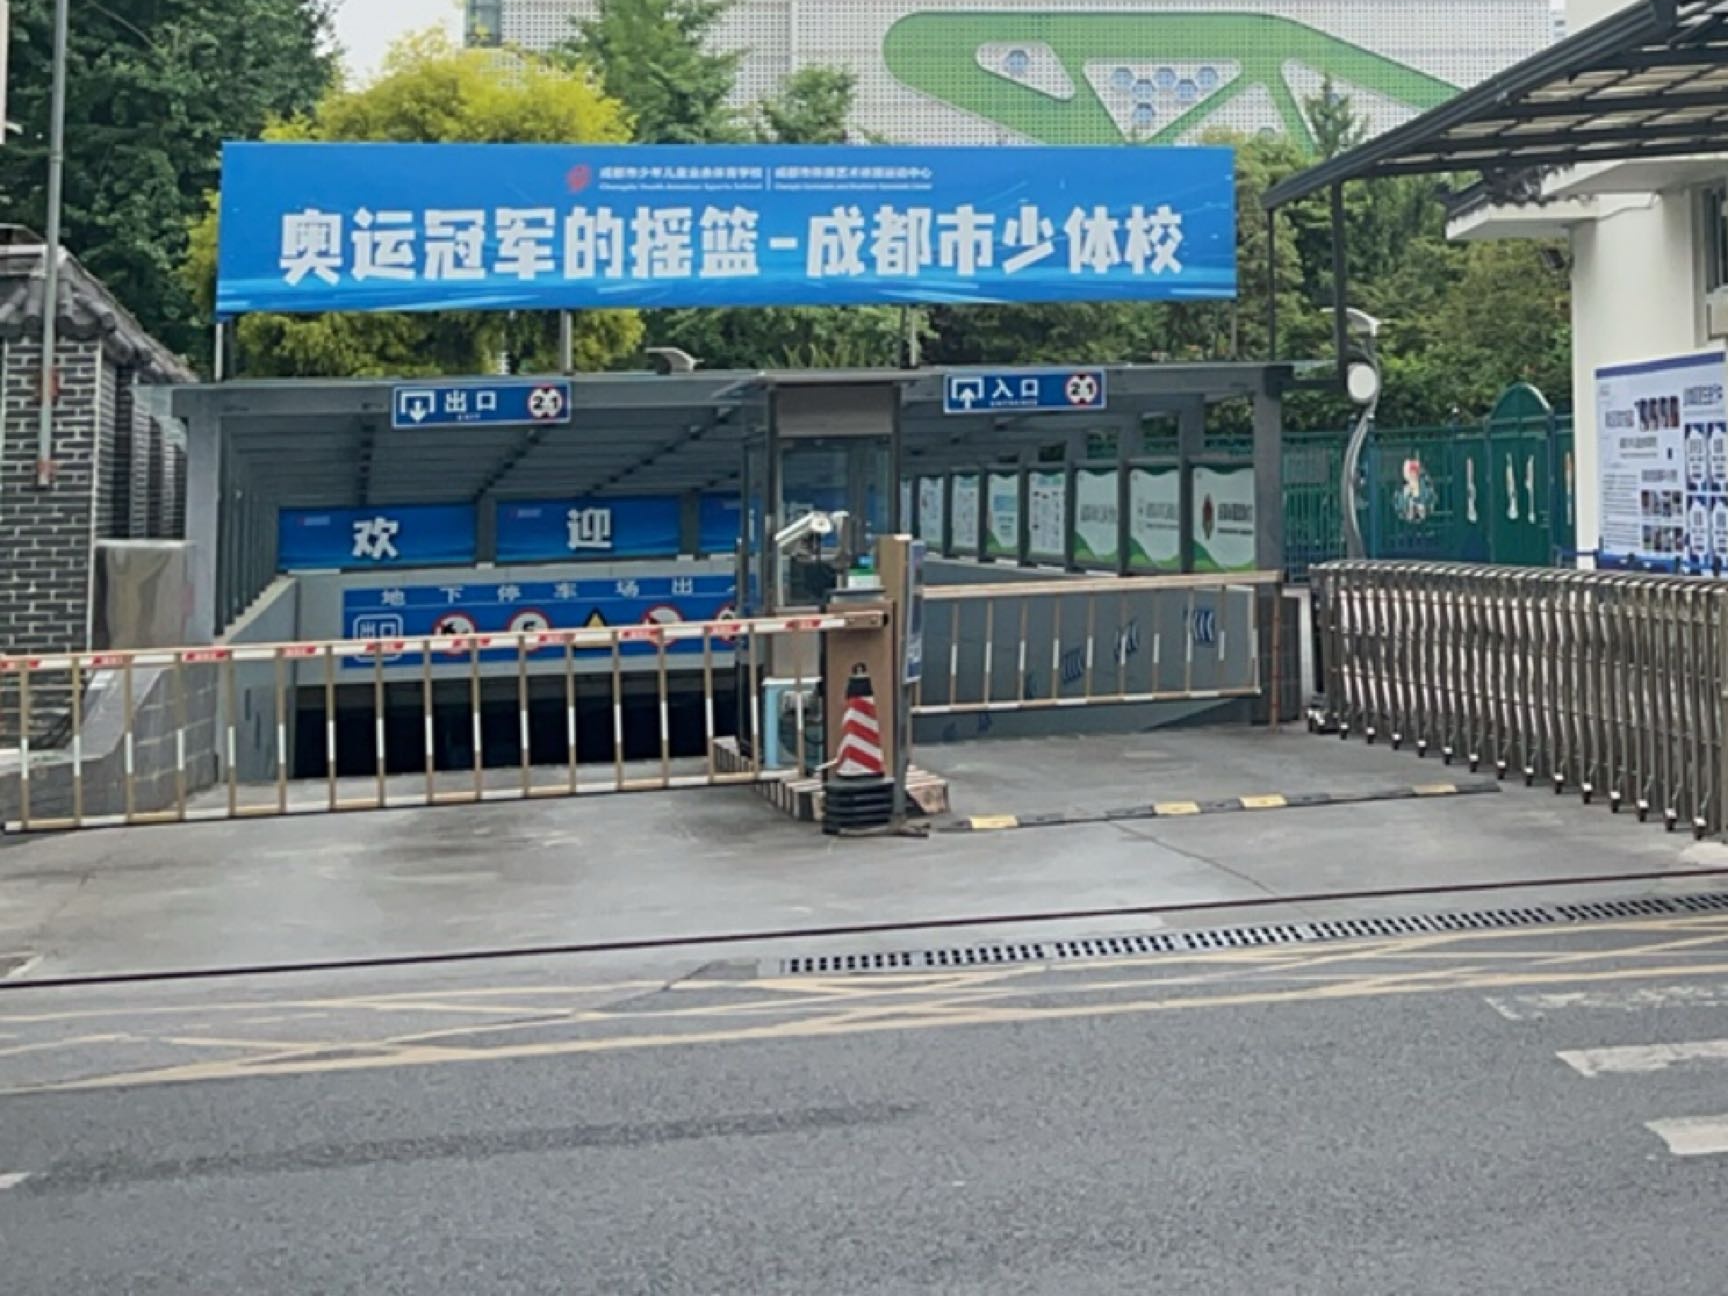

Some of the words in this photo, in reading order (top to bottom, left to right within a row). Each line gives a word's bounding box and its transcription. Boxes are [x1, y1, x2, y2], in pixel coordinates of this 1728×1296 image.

[279, 204, 1184, 285] 奥运冠军的摇篮-成都市少体校
[444, 390, 498, 413] 出口
[991, 377, 1039, 398] 入口
[351, 516, 400, 560] 欢
[567, 508, 613, 550] 迎
